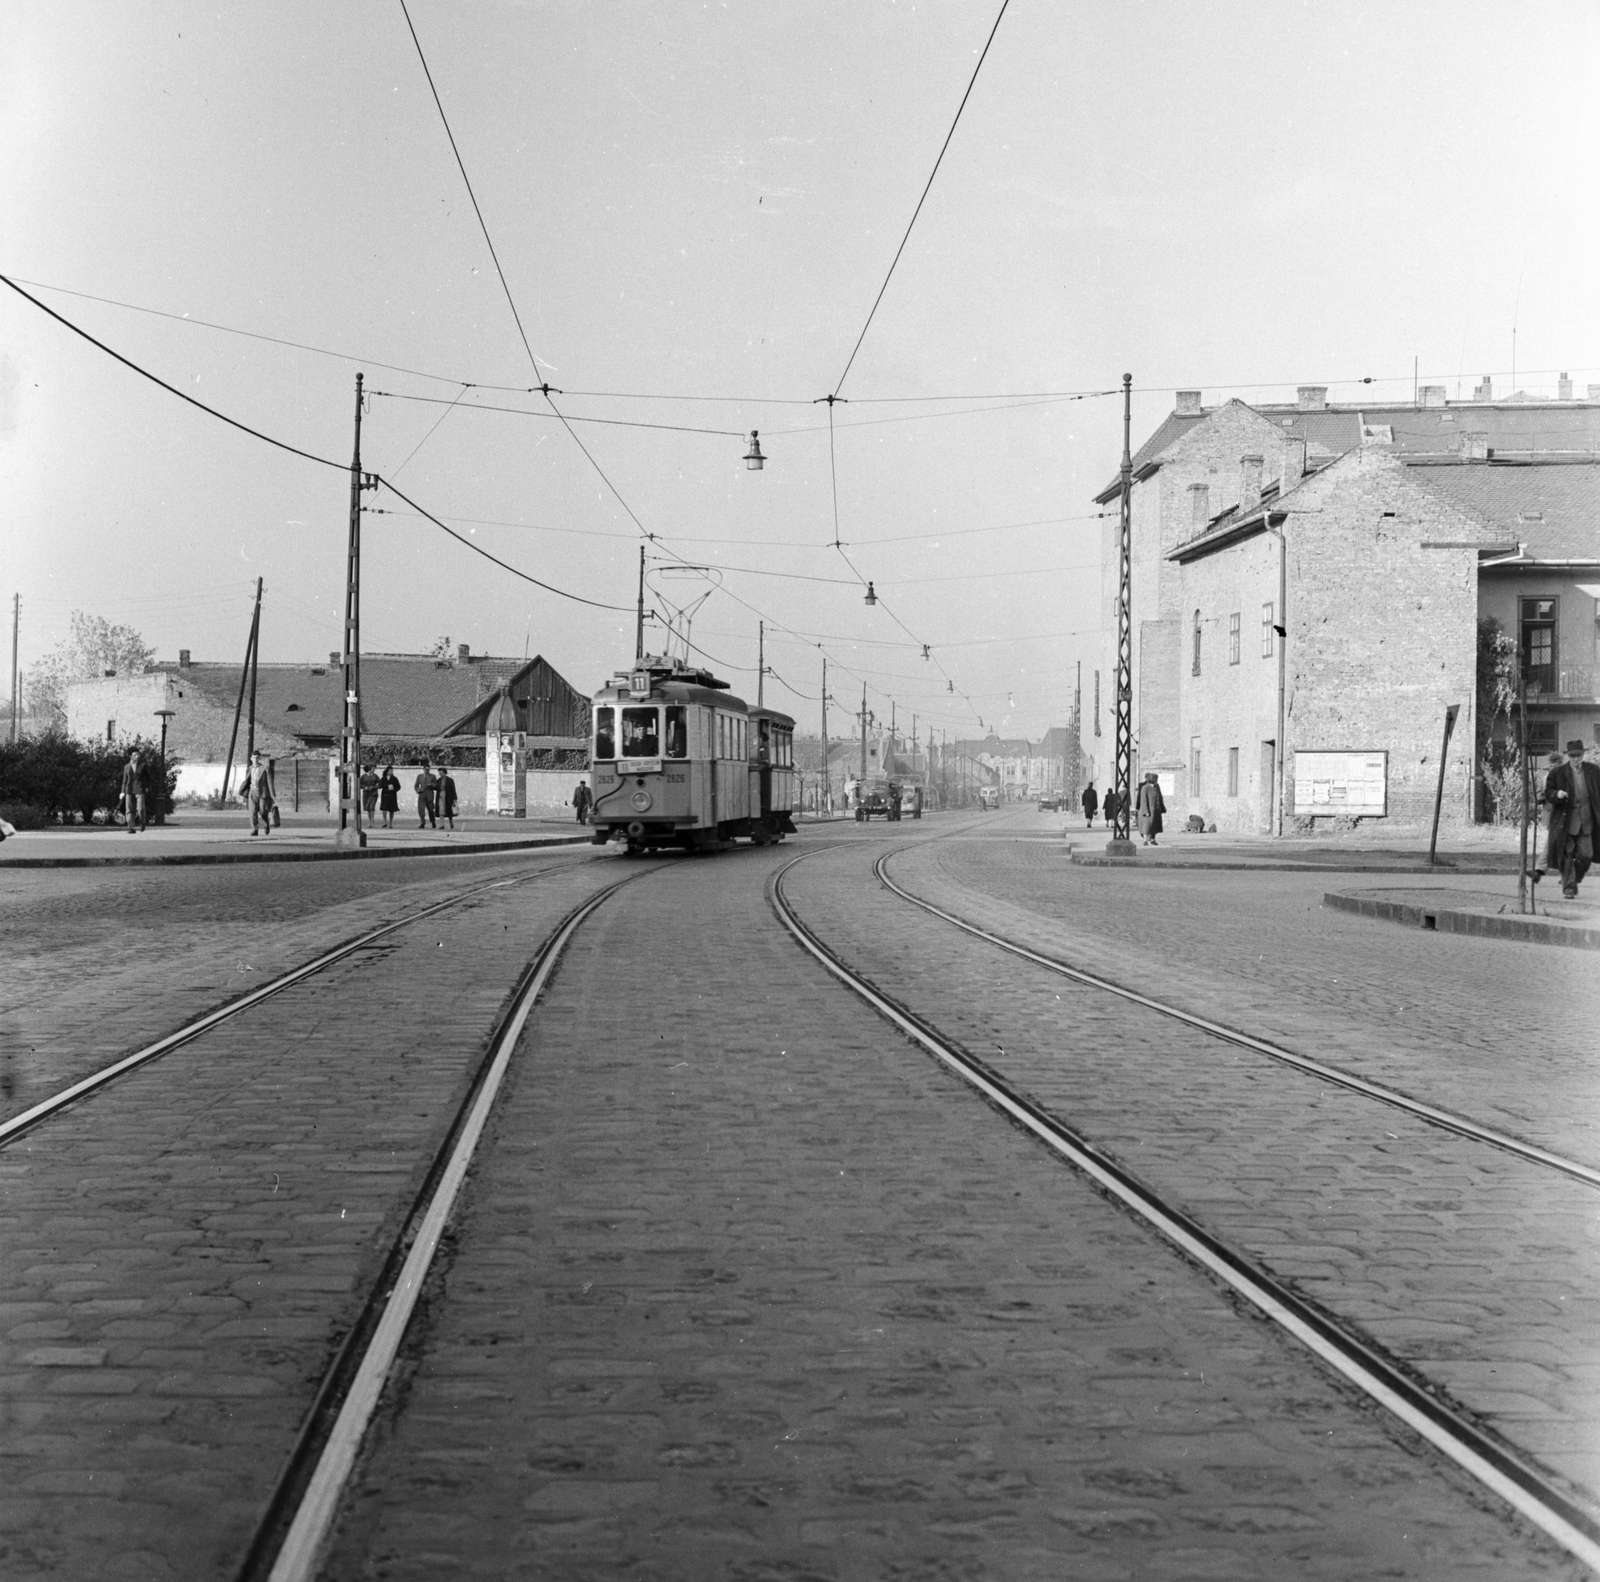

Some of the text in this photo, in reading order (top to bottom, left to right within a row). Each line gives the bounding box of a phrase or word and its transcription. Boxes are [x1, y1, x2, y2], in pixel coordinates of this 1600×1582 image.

[634, 677, 645, 690] 11
[622, 763, 628, 772] 11
[666, 774, 685, 783] 2626
